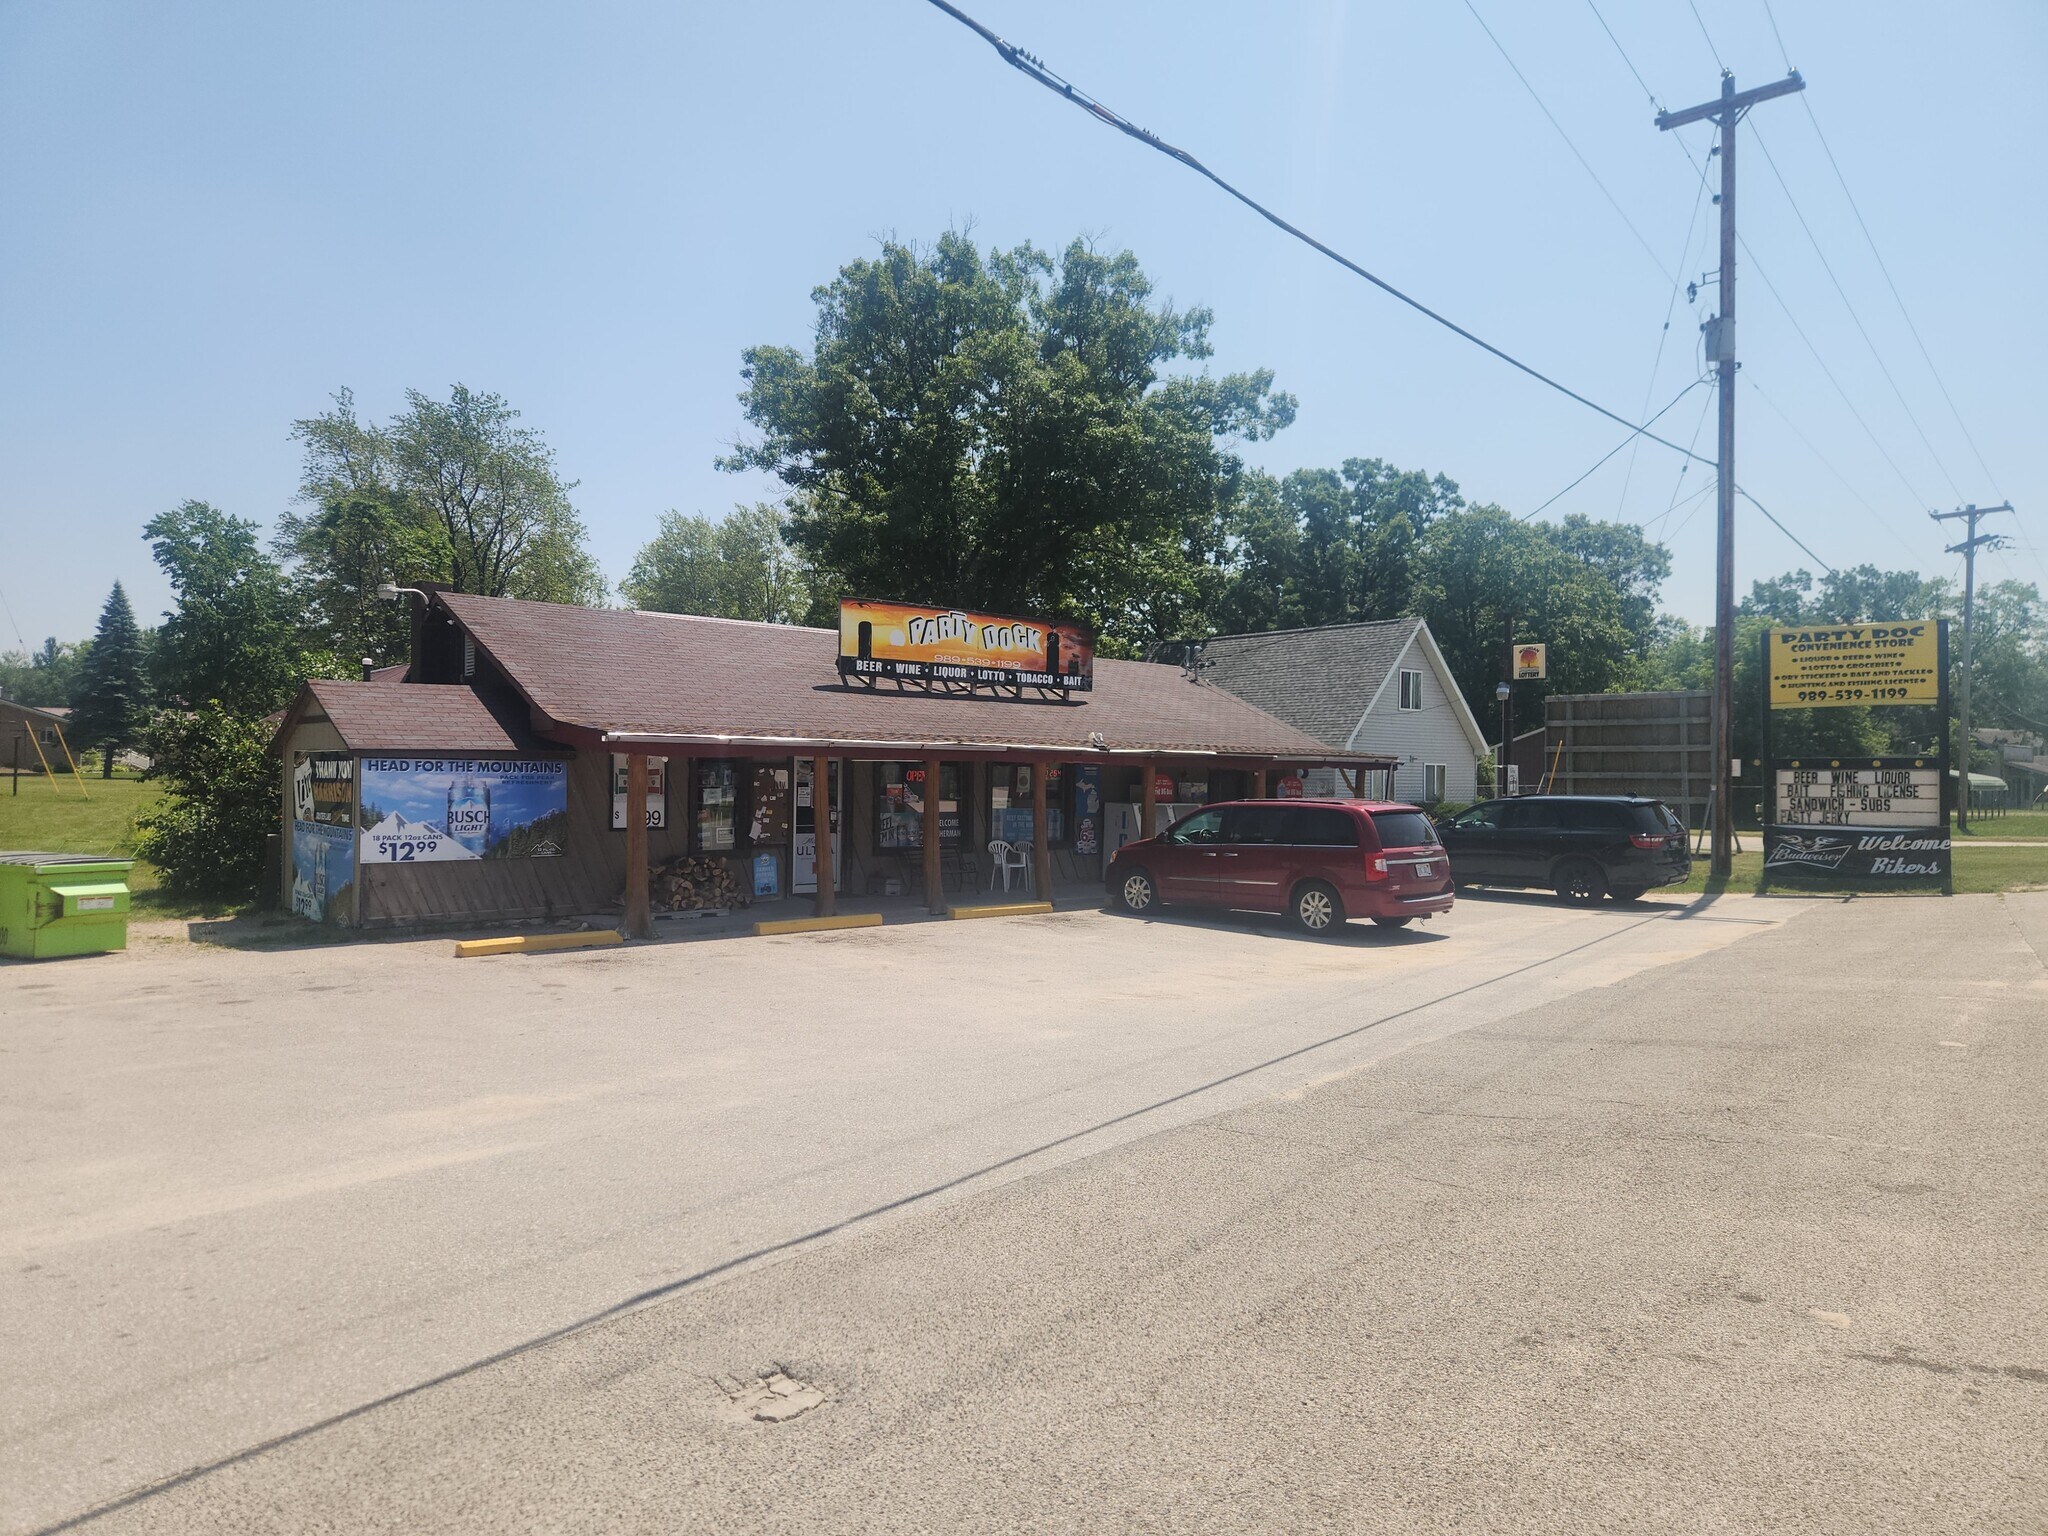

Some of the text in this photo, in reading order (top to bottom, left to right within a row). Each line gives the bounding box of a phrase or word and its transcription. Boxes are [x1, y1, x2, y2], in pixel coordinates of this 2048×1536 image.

[908, 611, 1043, 655] PARTY DOCK
[1781, 626, 1924, 644] PARTY DOC
[1791, 638, 1914, 652] CONVENIENCE STORE
[856, 660, 1082, 686] BEER WINE LIQUOR LOTTO TOBACCO BAIT
[1800, 672, 1841, 680] STICKERS
[1798, 687, 1908, 701] 989-539-1199
[315, 760, 338, 779] THANK
[368, 760, 562, 774] HEAD FOR THE MOUNTAINS
[1794, 771, 1911, 784] BEER WINE LIQUOR
[1787, 785, 1919, 798] BAIT FISHING LICENSE
[1790, 799, 1844, 811] SANDWICH
[1861, 800, 1891, 811] SUBS
[939, 819, 959, 827] ELCOME
[1781, 811, 1850, 825] PASTY JERKY
[1858, 834, 1951, 851] Welcome
[1776, 849, 1841, 861] Budweiser
[1870, 857, 1941, 874] Bikers
